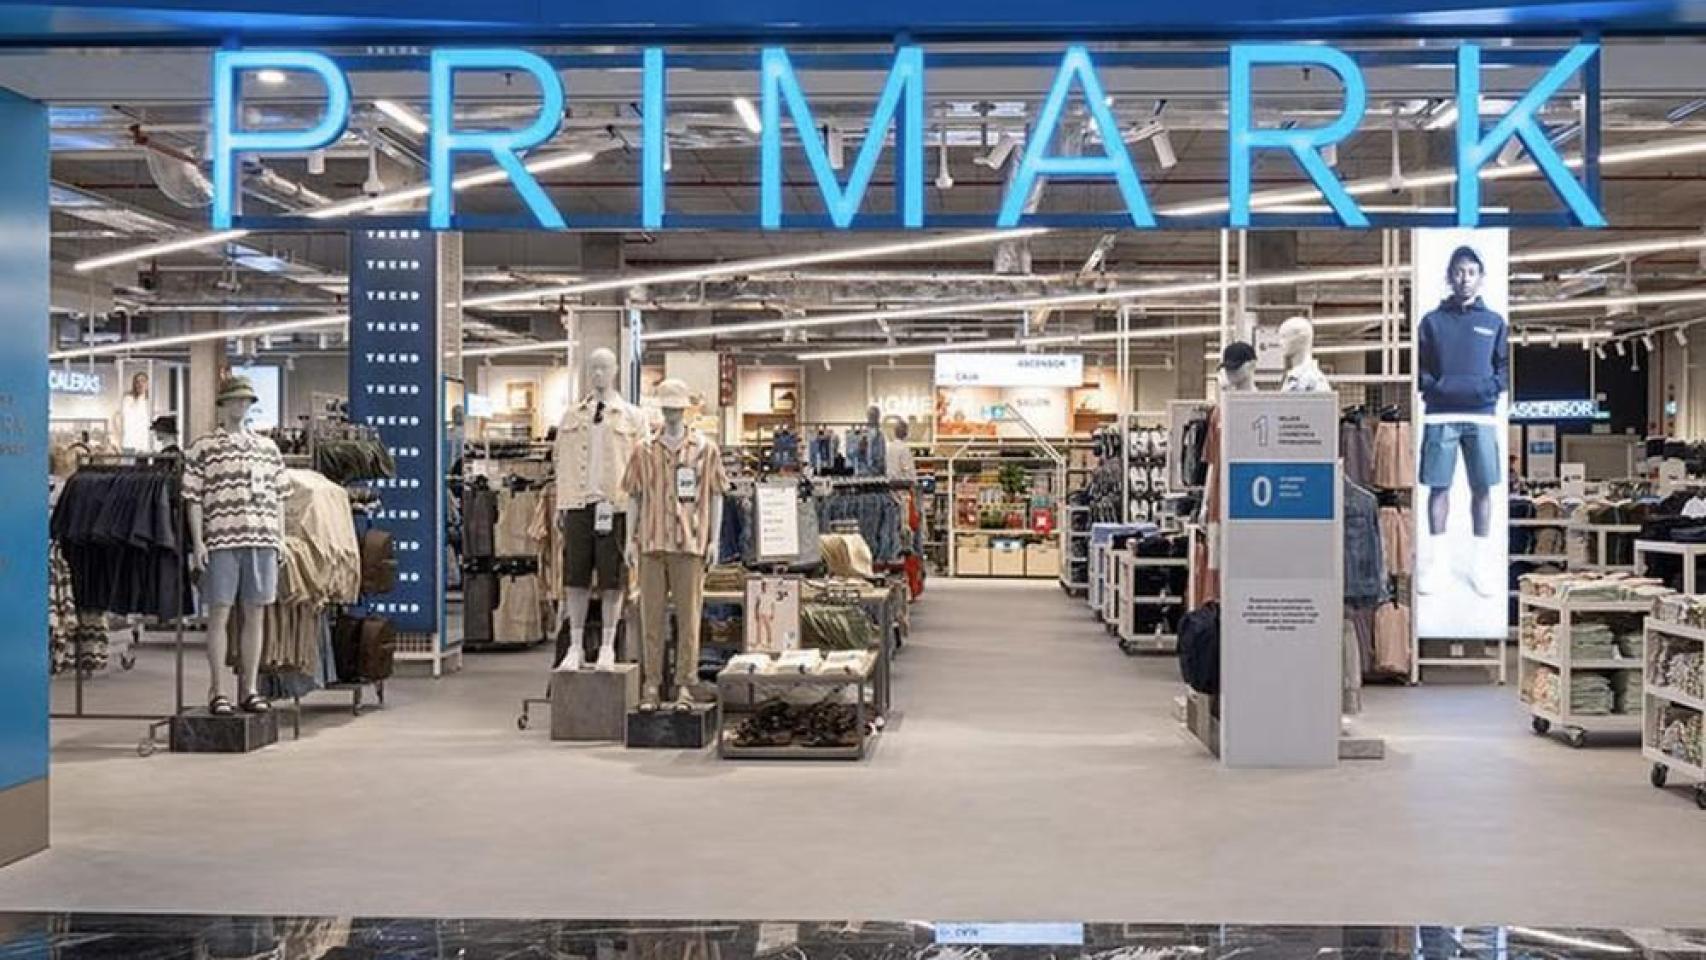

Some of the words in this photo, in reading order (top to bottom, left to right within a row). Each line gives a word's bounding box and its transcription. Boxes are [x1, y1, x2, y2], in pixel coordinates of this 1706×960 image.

[212, 44, 1606, 229] PRIMARK
[366, 260, 419, 269] TREND
[366, 291, 419, 300] TREND
[366, 322, 419, 331] TREND
[366, 353, 419, 362] TREND
[366, 384, 419, 393] TREND
[1508, 400, 1593, 417] ASCENSOR
[366, 415, 419, 425] TREND
[1251, 414, 1269, 447] 1
[1252, 476, 1272, 507] 0
